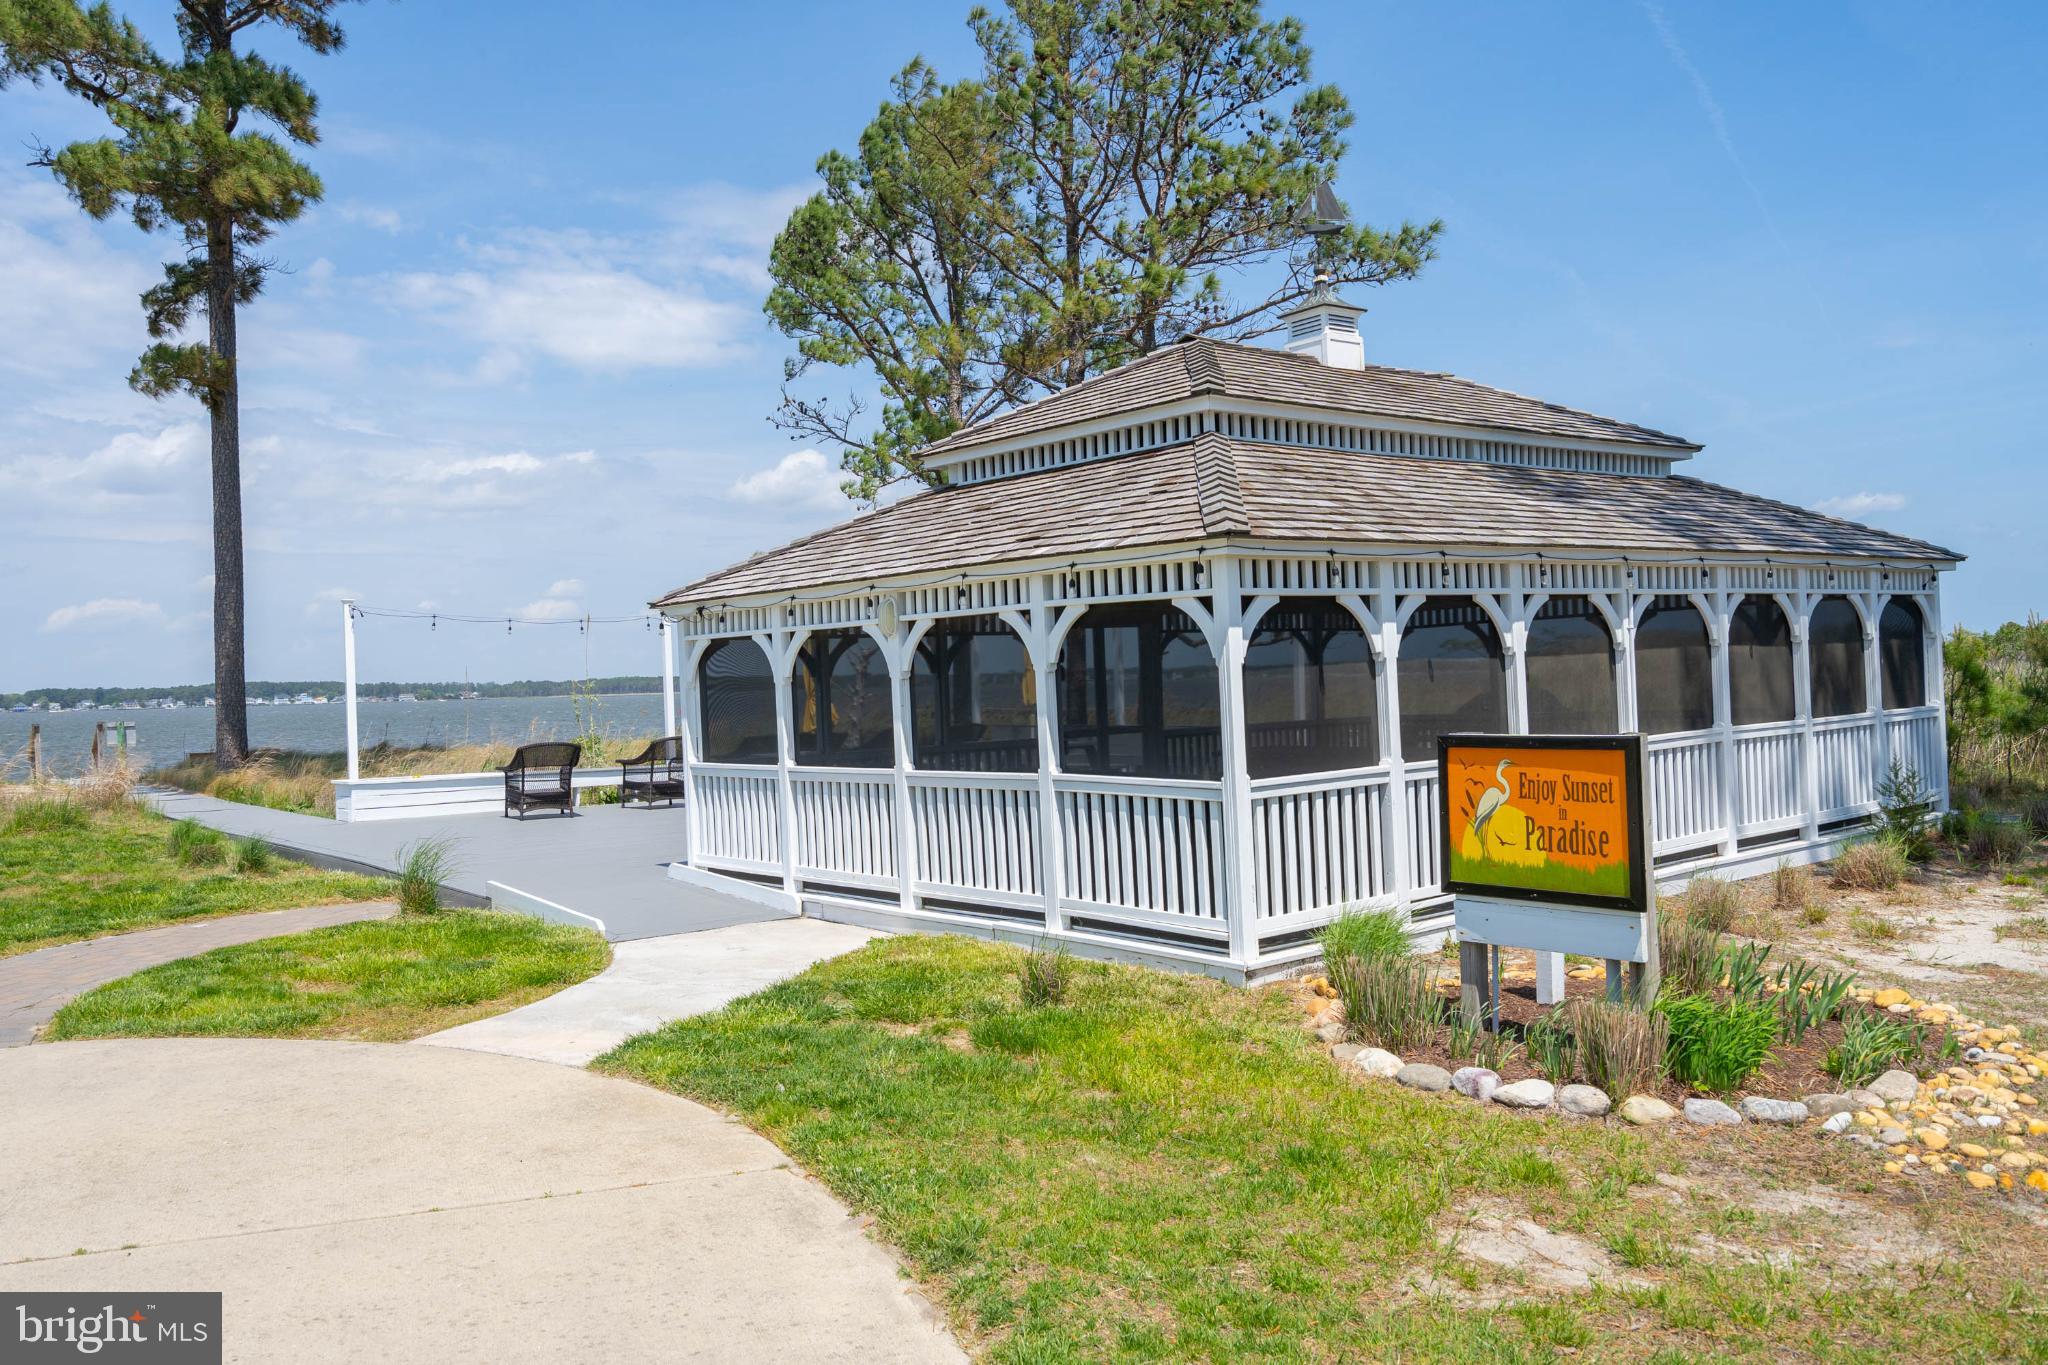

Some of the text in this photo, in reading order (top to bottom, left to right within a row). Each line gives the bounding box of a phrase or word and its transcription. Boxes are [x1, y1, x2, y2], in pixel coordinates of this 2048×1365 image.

[1518, 772, 1615, 805] Enjoy Sunset
[1558, 804, 1567, 821] in
[1524, 815, 1610, 858] Paradise
